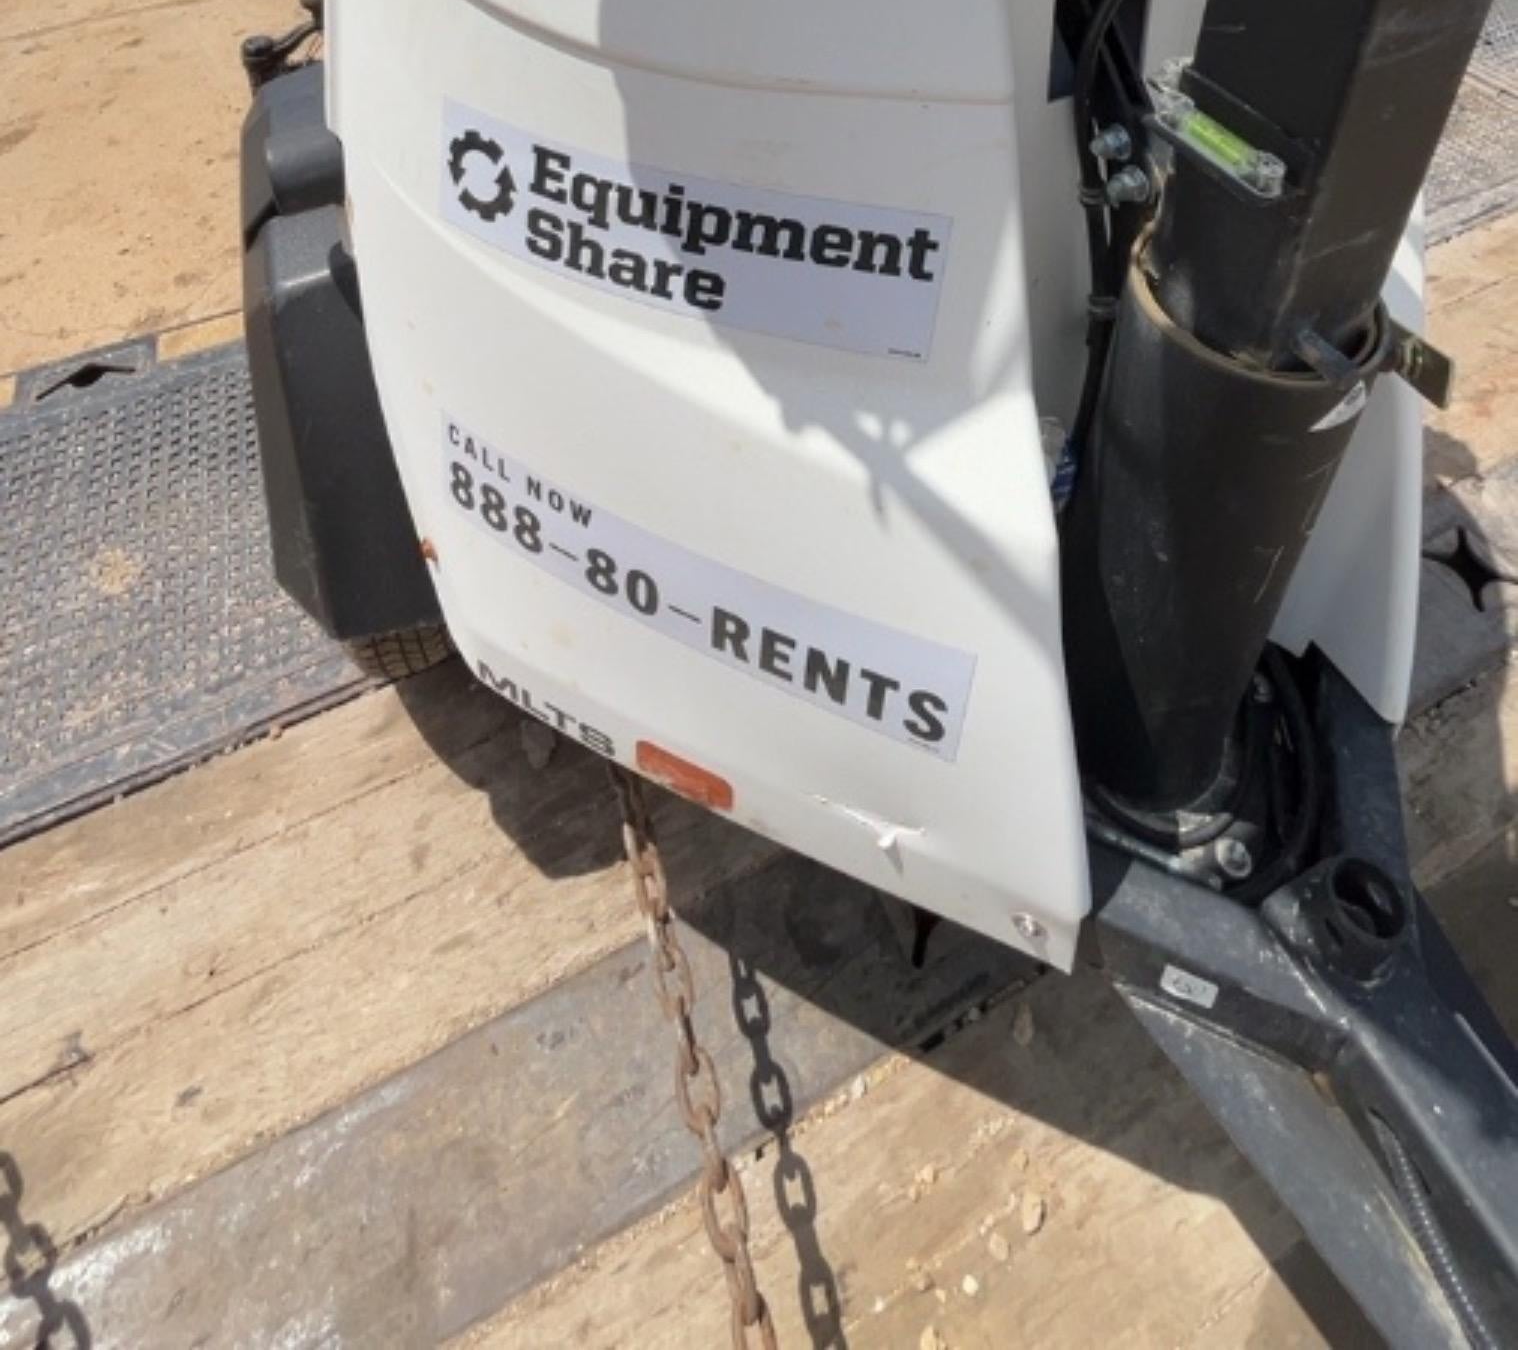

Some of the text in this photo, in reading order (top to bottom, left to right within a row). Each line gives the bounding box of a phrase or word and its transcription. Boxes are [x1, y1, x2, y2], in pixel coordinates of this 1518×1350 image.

[525, 207, 726, 311] Share
[528, 144, 940, 282] Equipment
[449, 423, 593, 528] CALL NOW
[477, 659, 617, 757] MLTS
